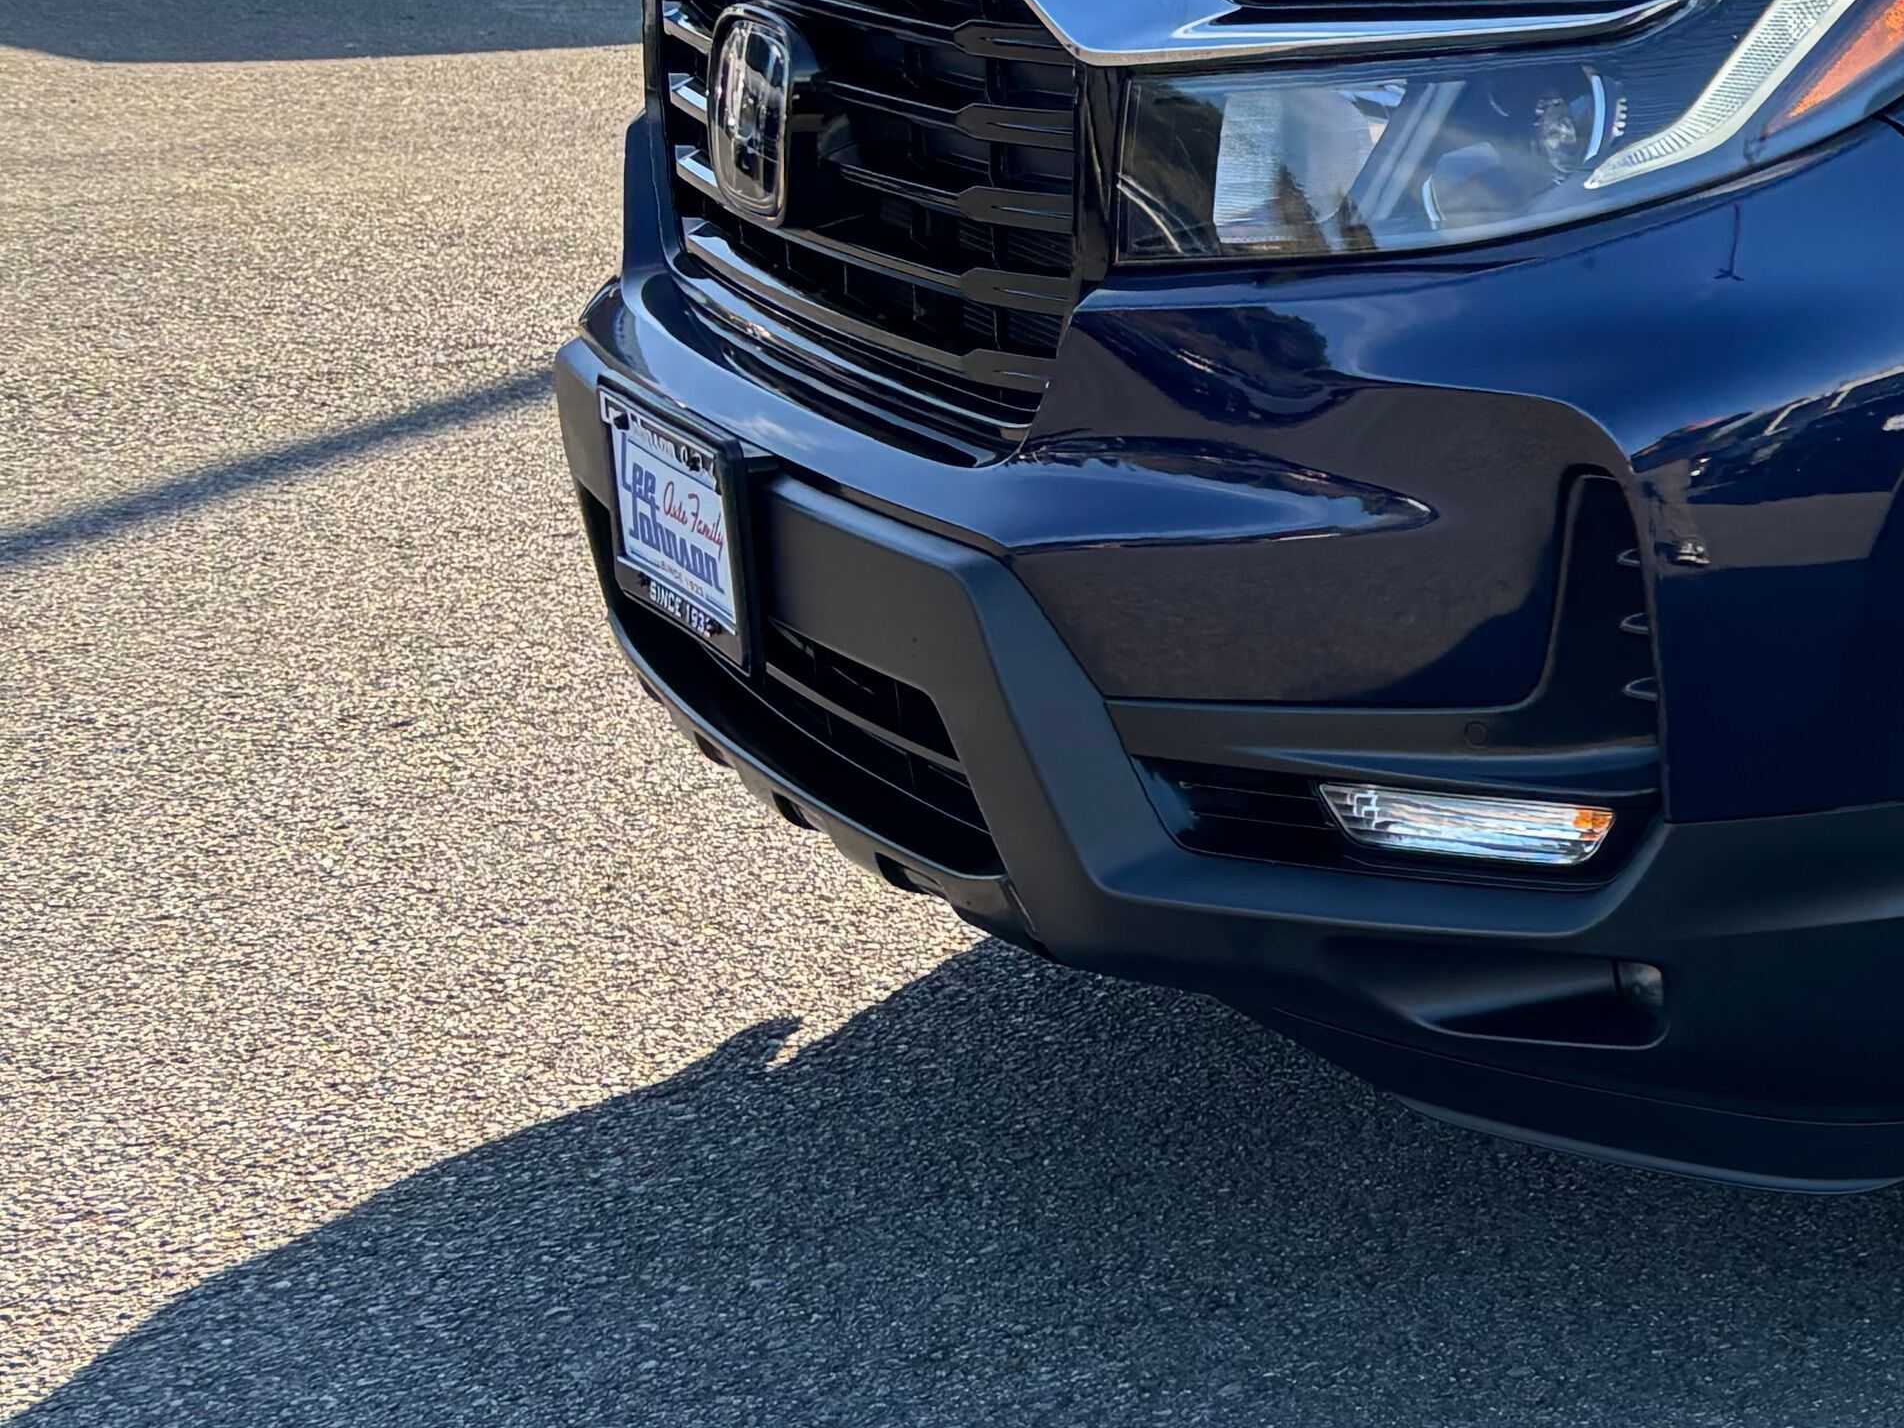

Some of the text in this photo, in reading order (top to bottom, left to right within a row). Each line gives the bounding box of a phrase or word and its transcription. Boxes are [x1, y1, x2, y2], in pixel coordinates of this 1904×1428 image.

[621, 431, 660, 512] Lee
[663, 480, 688, 526] Auto
[688, 492, 725, 559] Family
[629, 490, 725, 595] Johnson
[649, 581, 682, 615] SINCE
